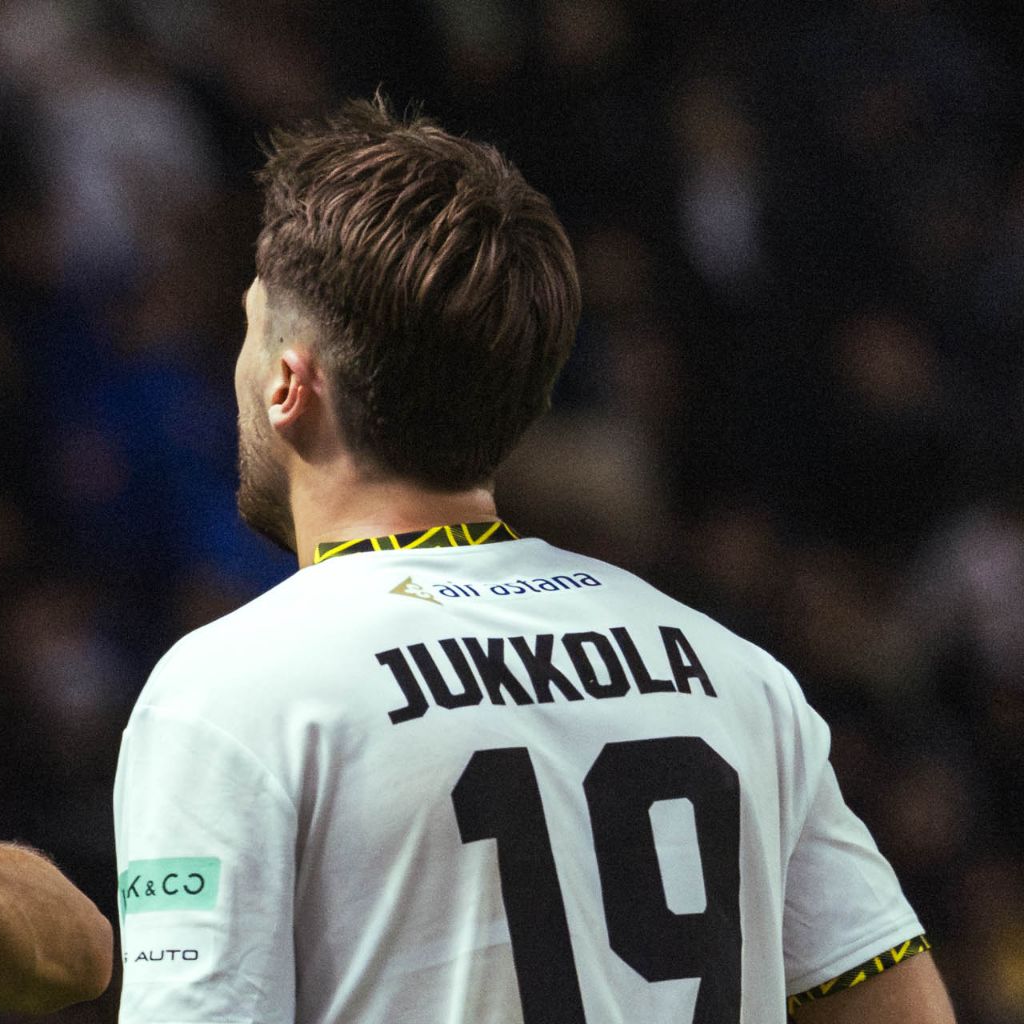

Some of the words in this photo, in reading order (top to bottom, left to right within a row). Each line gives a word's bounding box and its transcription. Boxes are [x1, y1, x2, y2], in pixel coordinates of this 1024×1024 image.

[438, 581, 480, 598] air
[490, 571, 602, 596] astana
[374, 625, 718, 725] JUKKOLA
[134, 949, 199, 962] AUTO
